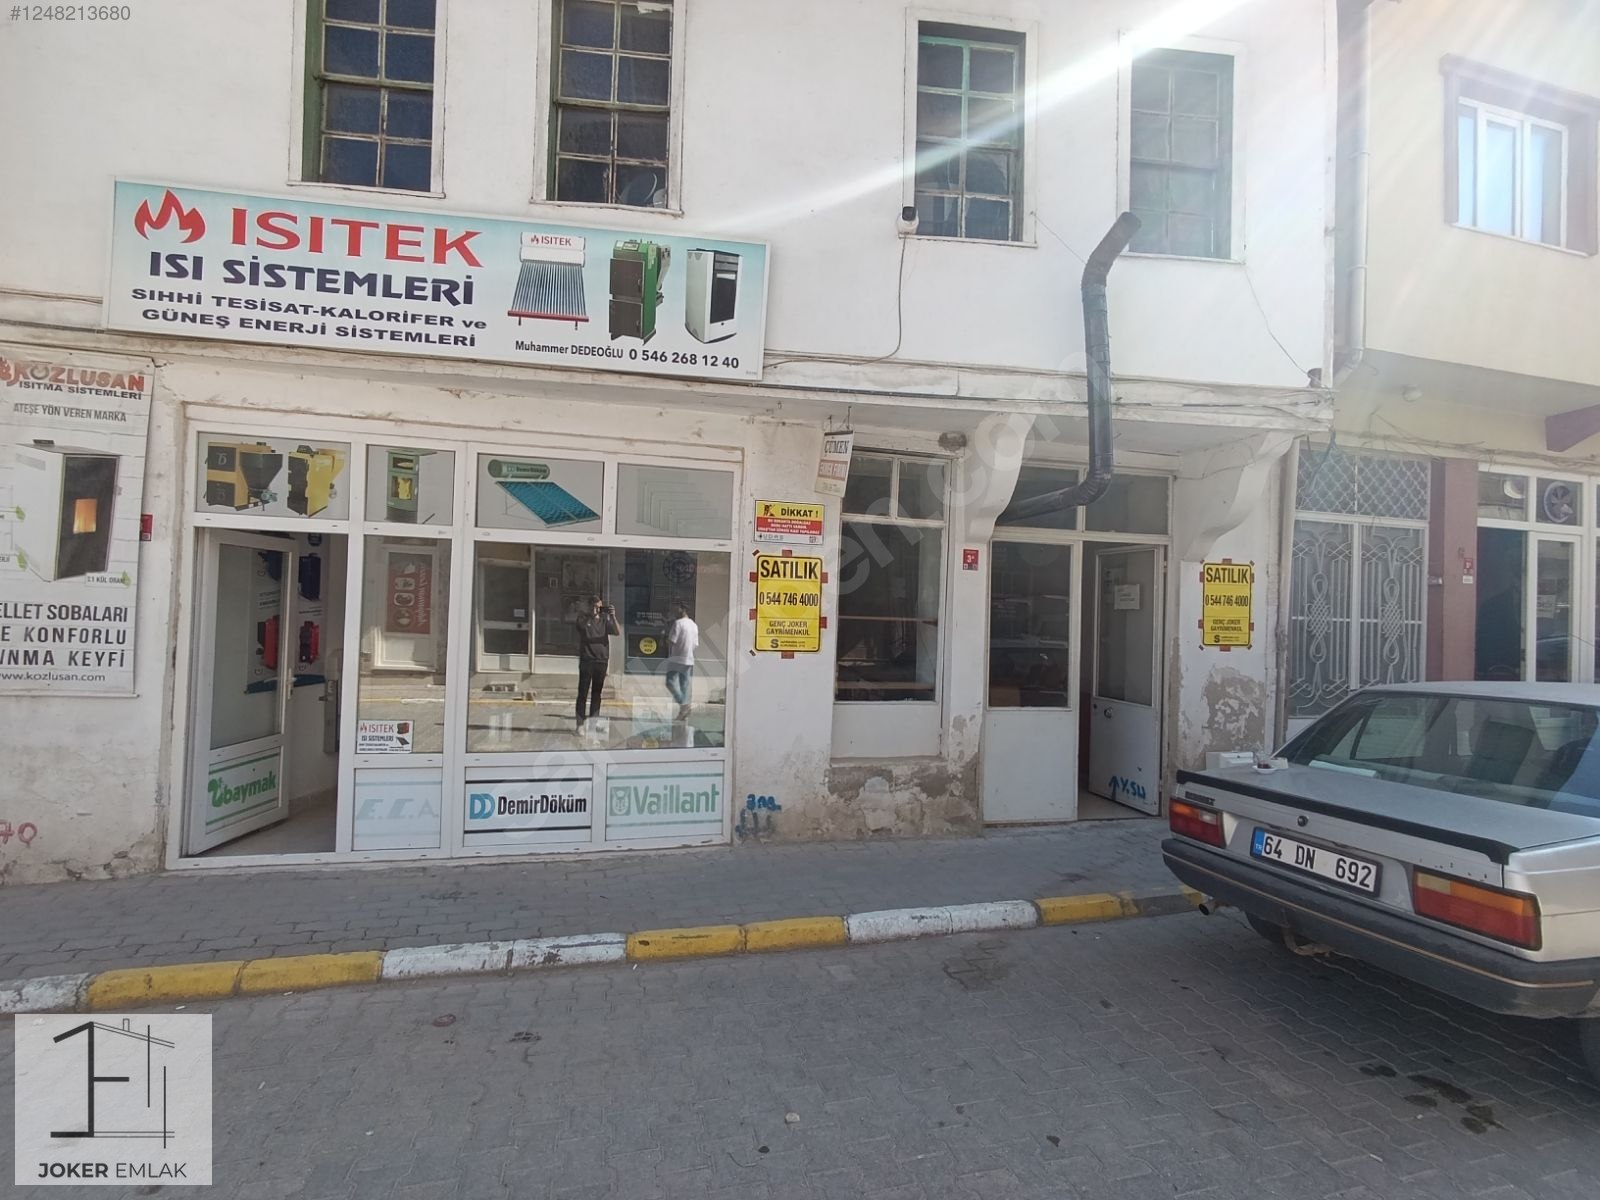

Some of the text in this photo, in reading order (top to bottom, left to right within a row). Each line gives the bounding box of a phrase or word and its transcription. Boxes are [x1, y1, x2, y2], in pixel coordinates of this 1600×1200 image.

[232, 207, 484, 268] ISITEK
[540, 235, 572, 247] ISITEK
[150, 252, 474, 307] ISI SİSTEMLERİ
[132, 288, 487, 330] SIHHİ TESİSAT-KALORİFER ve
[142, 308, 475, 347] GÜNEŞ ENERJİ SİSTEMLERİ
[515, 340, 739, 369] Muhammer DEDEOĞLU 0 546 268 12 40
[7, 362, 145, 392] KOZLUSAN
[19, 381, 142, 400] ISITMA SİSTEMLERİ
[13, 403, 127, 422] ATEŞE YÖN VEREN MARKA
[781, 507, 813, 518] DİKKAT
[760, 559, 818, 579] SATILIK
[1205, 567, 1249, 584] SATILIK
[759, 592, 819, 606] 0 544 746 4000
[1205, 594, 1249, 607] 0 544 746 4000
[47, 604, 128, 622] SOBALARI
[788, 621, 808, 629] JOKER
[23, 626, 127, 645] KONFORLU
[68, 649, 125, 668] KEYFİ
[0, 671, 106, 682] ww.kozlusan.com
[369, 724, 394, 733] ISITEK
[223, 770, 276, 804] baymak
[498, 794, 587, 816] DemirDöküm
[632, 783, 720, 816] Vaillant
[1264, 836, 1282, 860] 64
[1295, 844, 1316, 870] DN
[1335, 858, 1372, 889] 692
